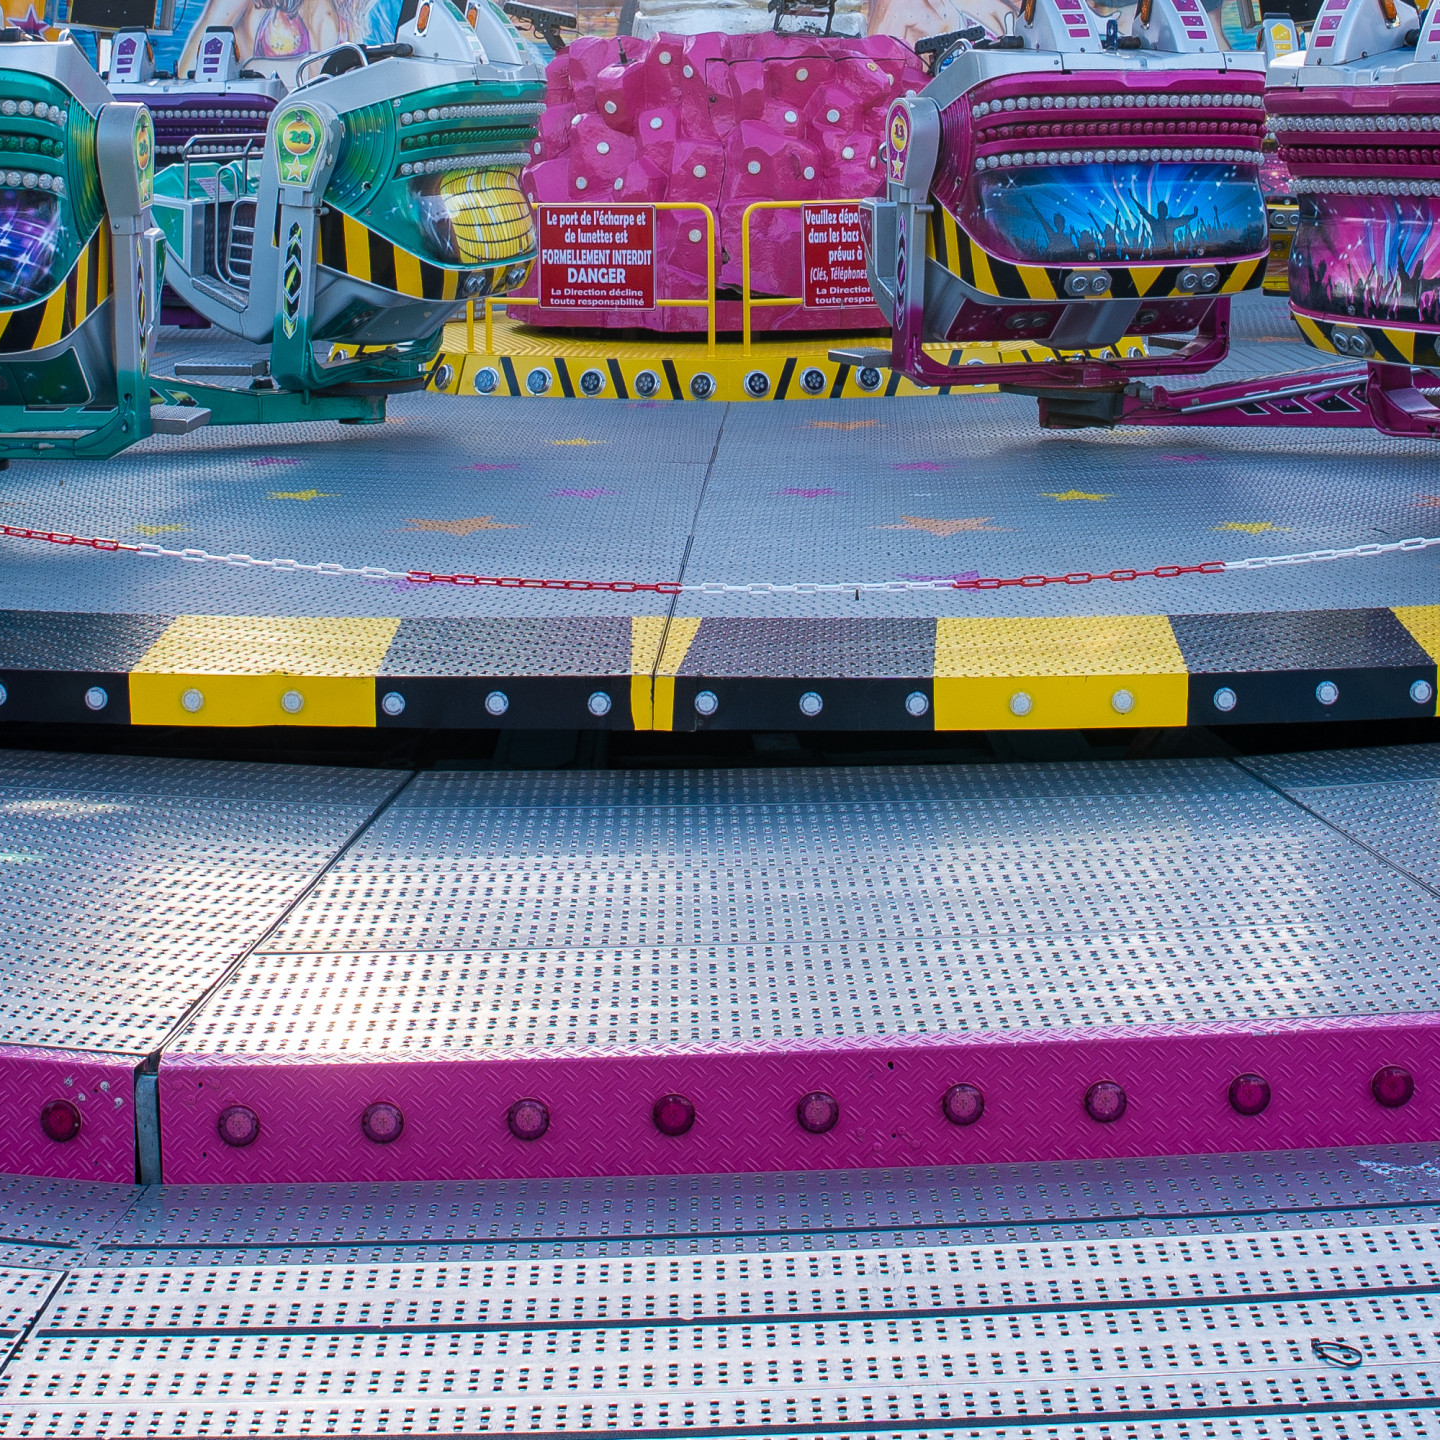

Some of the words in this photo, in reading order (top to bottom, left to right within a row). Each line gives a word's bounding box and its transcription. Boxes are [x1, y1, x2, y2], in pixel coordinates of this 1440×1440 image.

[546, 210, 557, 226] Le
[559, 211, 578, 228] port
[580, 210, 591, 226] de
[593, 210, 634, 228] l'écharpe
[636, 211, 646, 226] et
[805, 209, 837, 225] Veuillez
[564, 228, 576, 243] de
[577, 228, 613, 244] lunettes
[615, 229, 628, 244] est
[808, 228, 827, 243] dans
[829, 227, 840, 243] les
[841, 227, 859, 242] bacs
[542, 249, 611, 265] FORMELLEMENT
[612, 250, 652, 265] INTERDIT
[828, 245, 855, 264] prévus
[856, 245, 863, 260] à
[567, 268, 626, 284] DANGER
[810, 267, 828, 283] (Clés,
[830, 266, 867, 282] Téléphones
[551, 288, 561, 296] La
[564, 288, 607, 296] Direction
[609, 288, 643, 297] décline
[816, 287, 827, 295] La
[578, 298, 644, 306] responsabilité
[815, 296, 841, 304] toute
